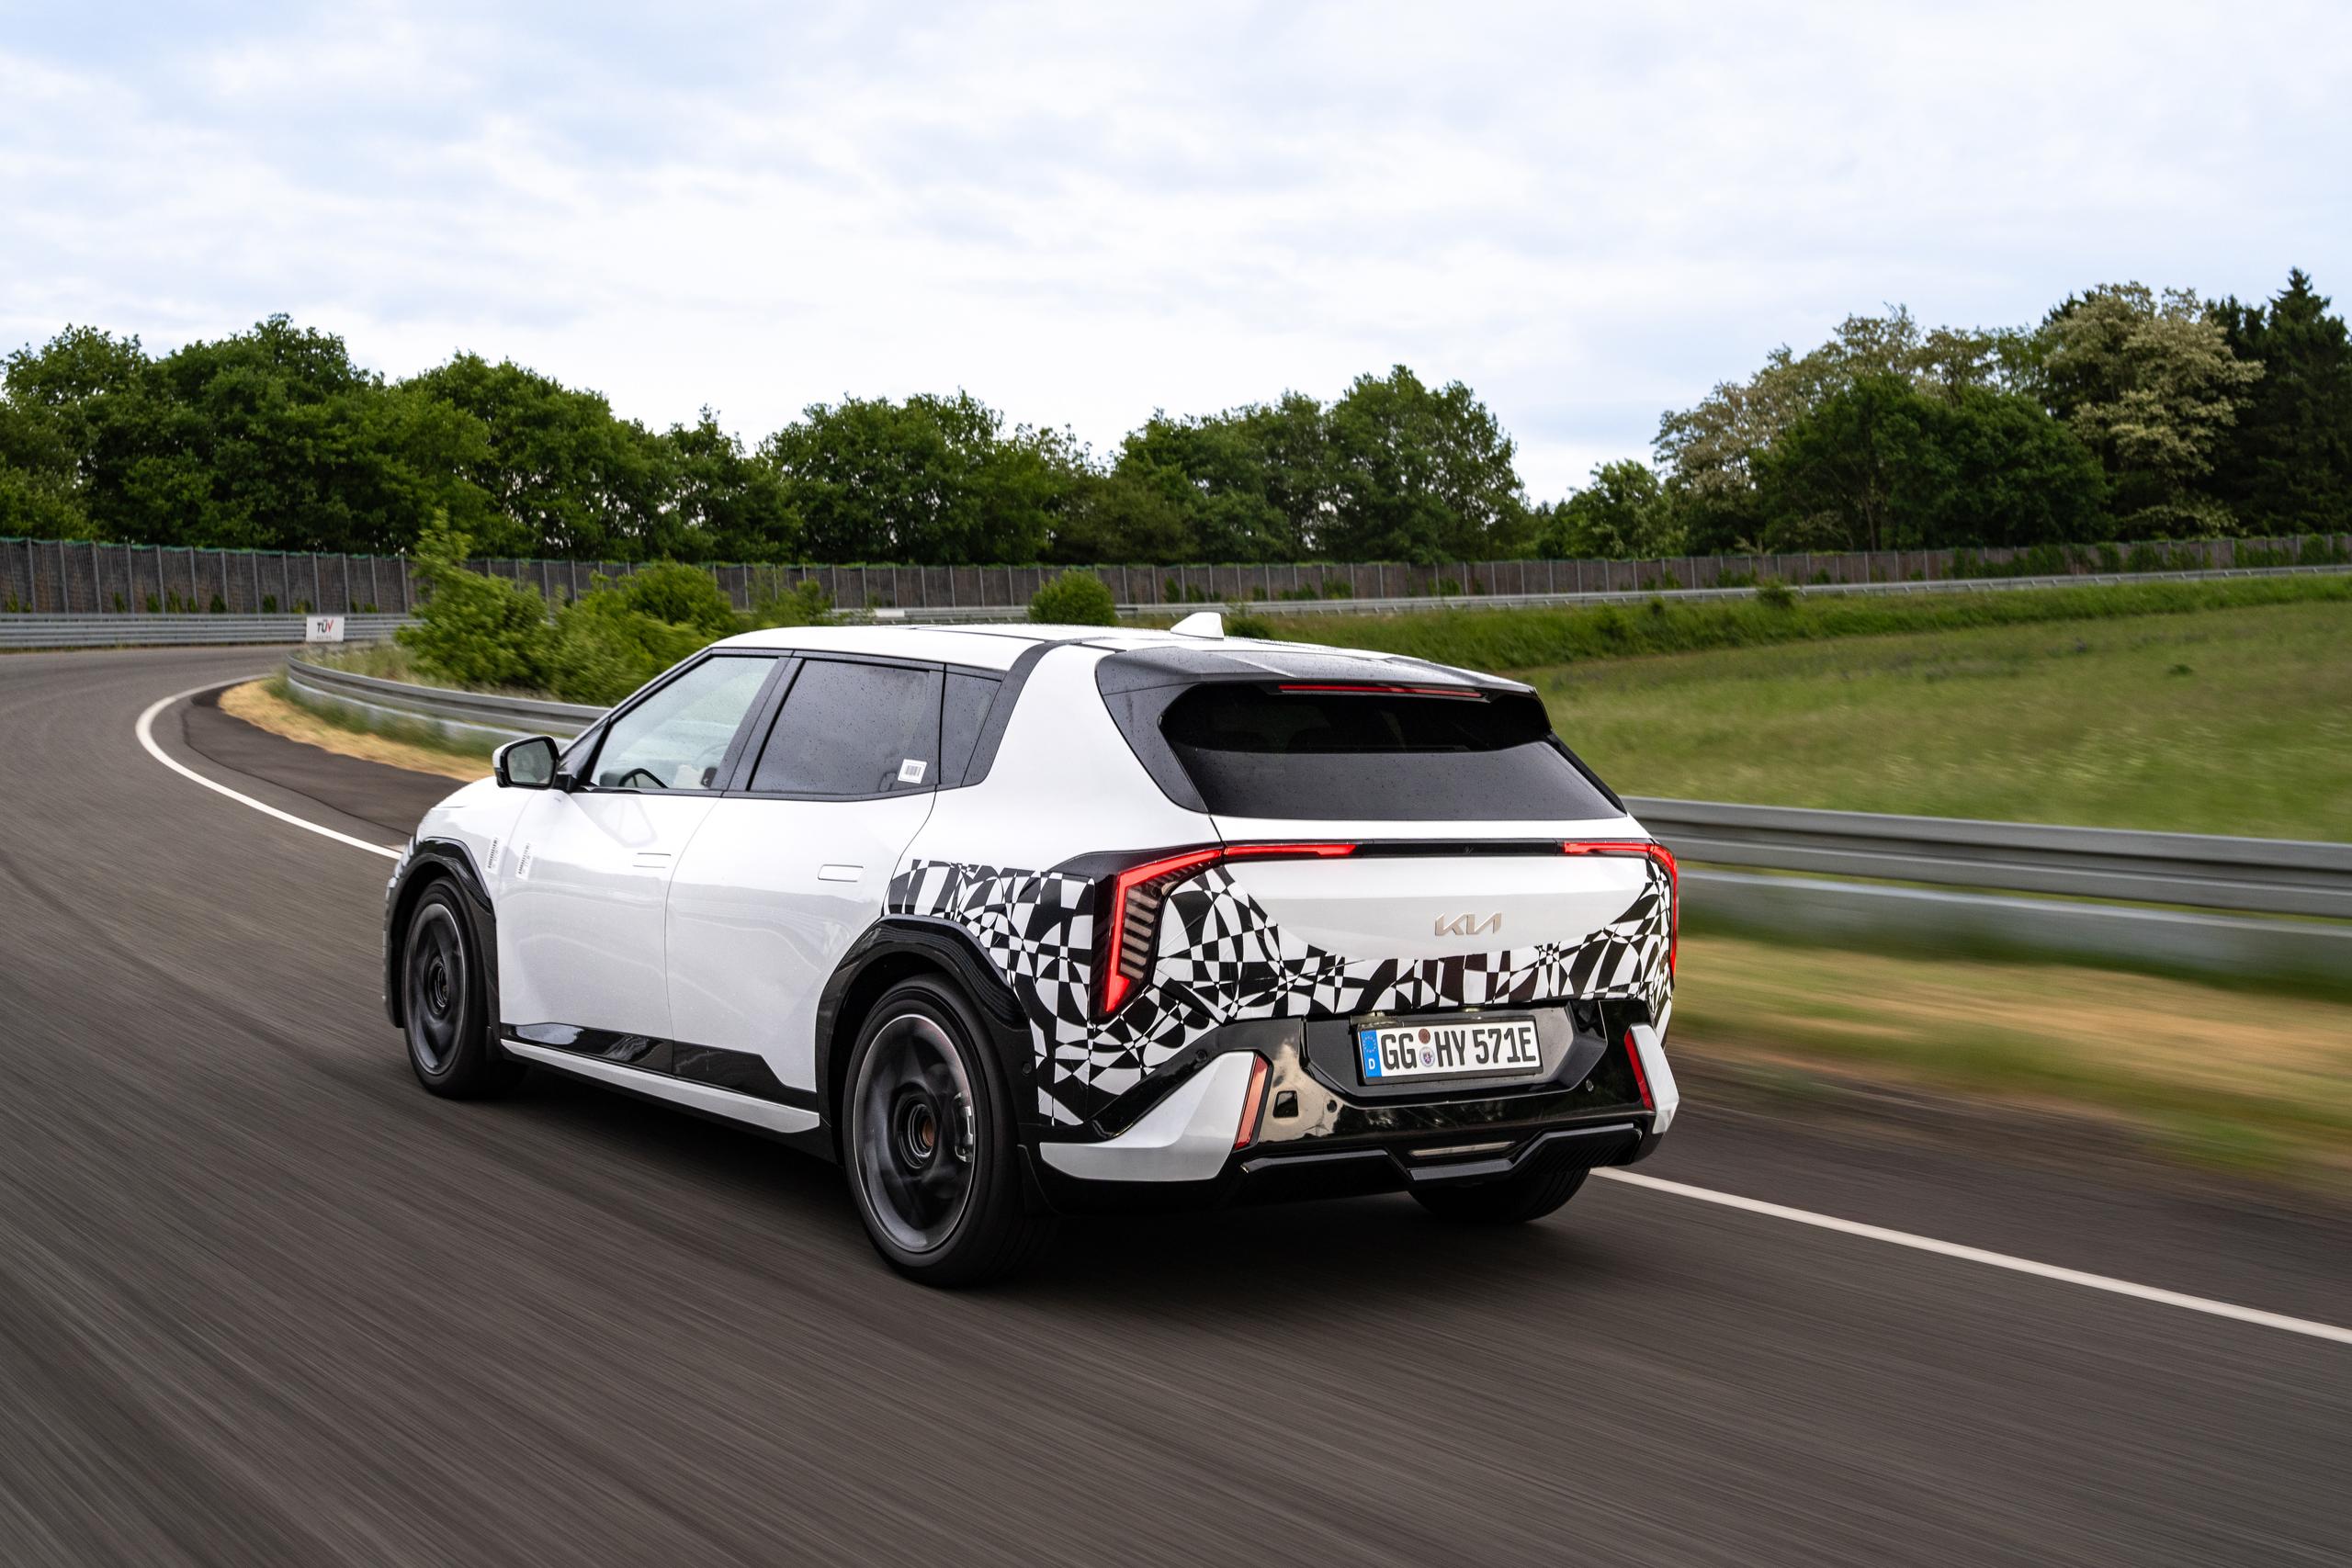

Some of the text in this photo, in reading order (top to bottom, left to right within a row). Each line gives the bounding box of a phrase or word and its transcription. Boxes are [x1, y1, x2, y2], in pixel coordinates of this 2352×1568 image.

[1434, 911, 1502, 936] KIA
[1380, 1026, 1537, 1071] GG HY 571E
[1368, 1057, 1375, 1070] D
